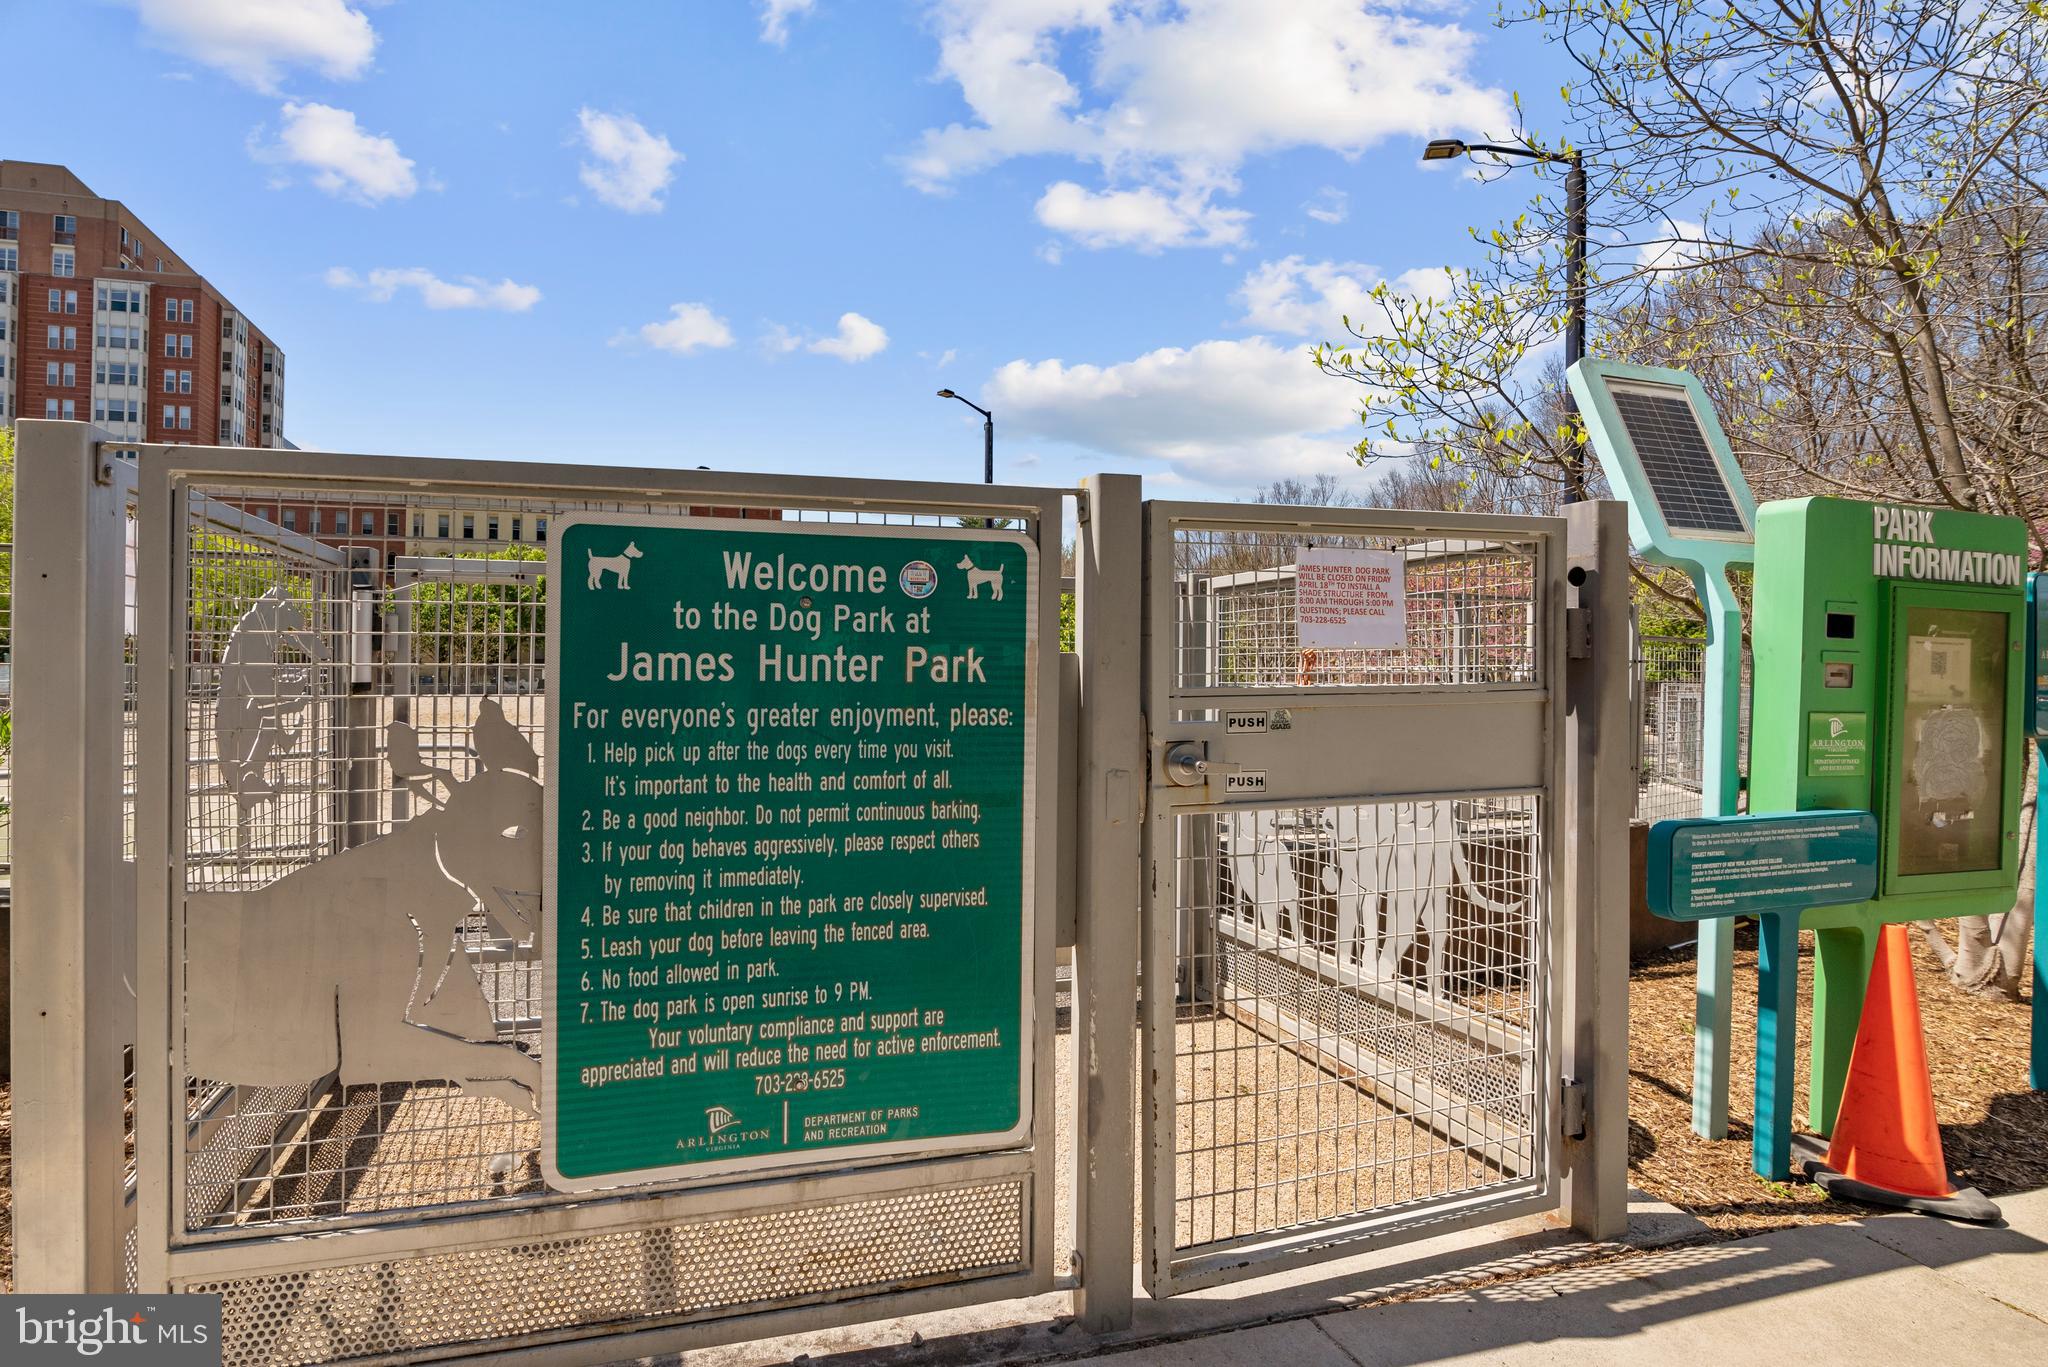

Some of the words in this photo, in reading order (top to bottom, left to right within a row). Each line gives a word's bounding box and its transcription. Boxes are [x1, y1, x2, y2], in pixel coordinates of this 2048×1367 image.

[1873, 506, 1934, 544] PARK
[723, 551, 887, 593] Welcome
[1299, 565, 1320, 573] JAMES
[1355, 567, 1371, 575] DOG
[1316, 573, 1326, 581] BE
[1327, 574, 1354, 582] CLOSED
[1367, 575, 1391, 583] FRIDAY
[1873, 543, 2021, 586] INFORMATION
[1299, 589, 1321, 597] SHADE
[1323, 590, 1364, 598] STRUCTURE
[1367, 591, 1388, 599] FROM
[1299, 597, 1315, 605] 8:00
[1329, 598, 1365, 606] THROUGH
[1337, 582, 1346, 590] TO
[673, 600, 701, 630] to
[711, 601, 757, 631] the
[769, 602, 821, 641] Dog
[834, 604, 895, 633] Park
[905, 606, 930, 634] at
[1343, 607, 1367, 615] PLEASE
[1369, 608, 1385, 616] CALL
[607, 642, 735, 682] James
[759, 644, 884, 683] Hunter
[906, 646, 987, 683] Park
[573, 702, 609, 729] For
[621, 701, 735, 735] everyone's
[747, 702, 819, 735] greater
[830, 702, 939, 735] enjoyment,
[950, 702, 1013, 732] please:
[1228, 717, 1265, 728] PUSH
[587, 742, 596, 763] 1.
[605, 742, 637, 767] Help
[645, 742, 675, 767] pick
[683, 746, 701, 766] up
[708, 740, 740, 761] after
[747, 741, 769, 761] the
[776, 741, 807, 766] dogs
[814, 744, 852, 764] every
[858, 739, 887, 759] time
[894, 743, 918, 763] you
[925, 738, 954, 758] visit.
[1812, 739, 1864, 747] ARLINGTON
[605, 775, 626, 797] It's
[635, 774, 708, 800] important
[715, 773, 729, 794] to
[737, 773, 761, 793] the
[768, 772, 812, 792] health
[819, 771, 846, 791] and
[853, 769, 907, 791] comfort
[913, 769, 927, 789] of
[933, 769, 953, 789] all.
[1228, 776, 1264, 787] PUSH
[582, 809, 595, 831] 2.
[603, 809, 621, 830] Be
[627, 813, 636, 829] a
[643, 807, 677, 835] good
[685, 806, 748, 833] neighbor.
[755, 804, 773, 825] Do
[780, 804, 801, 824] not
[807, 802, 850, 827] permit
[856, 801, 925, 822] continuous
[931, 799, 981, 825] barking.
[581, 841, 594, 863] 3.
[602, 841, 612, 862] If
[619, 844, 652, 867] your
[659, 839, 685, 865] dog
[692, 837, 747, 858] behaves
[844, 833, 884, 857] please
[891, 830, 936, 854] respect
[941, 829, 980, 849] others
[605, 874, 622, 899] by
[630, 870, 695, 896] removing
[703, 868, 713, 889] it
[719, 865, 804, 889] immediately.
[581, 906, 594, 927] 4.
[603, 905, 621, 926] Be
[627, 907, 658, 925] sure
[664, 901, 692, 922] that
[699, 898, 754, 920] children
[761, 897, 773, 917] in
[779, 895, 802, 916] the
[808, 893, 837, 919] park
[843, 896, 864, 912] are
[870, 890, 914, 914] closely
[919, 886, 988, 912] supervised.
[581, 938, 593, 960] 5.
[601, 935, 642, 958] Leash
[649, 937, 681, 960] your
[688, 931, 713, 957] dog
[721, 928, 763, 950] before
[769, 925, 817, 951] leaving
[823, 923, 845, 943] the
[851, 920, 893, 941] fenced
[899, 923, 930, 939] area.
[581, 971, 594, 992] 6.
[602, 968, 621, 990] No
[628, 965, 659, 987] food
[666, 961, 719, 985] allowed
[727, 960, 739, 980] in
[747, 957, 779, 983] park.
[580, 1001, 593, 1024] 7.
[600, 1000, 626, 1022] The
[633, 998, 659, 1024] dog
[667, 994, 697, 1021] park
[705, 992, 715, 1013] is
[722, 994, 755, 1015] open
[761, 986, 809, 1009] sunrise
[814, 984, 827, 1004] to
[834, 982, 843, 1002] 9
[849, 981, 872, 1001] PM.
[648, 1027, 682, 1049] Your
[687, 1021, 753, 1045] voluntary
[759, 1015, 835, 1041] compliance
[840, 1011, 865, 1033] and
[870, 1007, 919, 1033] support
[923, 1009, 944, 1027] are
[581, 1055, 664, 1088] appreciated
[671, 1051, 697, 1075] and
[703, 1049, 729, 1072] will
[735, 1046, 782, 1069] reduce
[787, 1043, 809, 1064] the
[815, 1039, 847, 1061] need
[853, 1037, 872, 1058] for
[877, 1034, 915, 1056] active
[921, 1027, 1001, 1053] enforcement.
[803, 1129, 824, 1142] AND
[828, 1123, 887, 1139] RECREATION
[804, 1111, 867, 1128] DEPARTMENT
[870, 1109, 883, 1121] OF
[887, 1106, 919, 1120] PARKS
[676, 1129, 770, 1149] ARLINGTON
